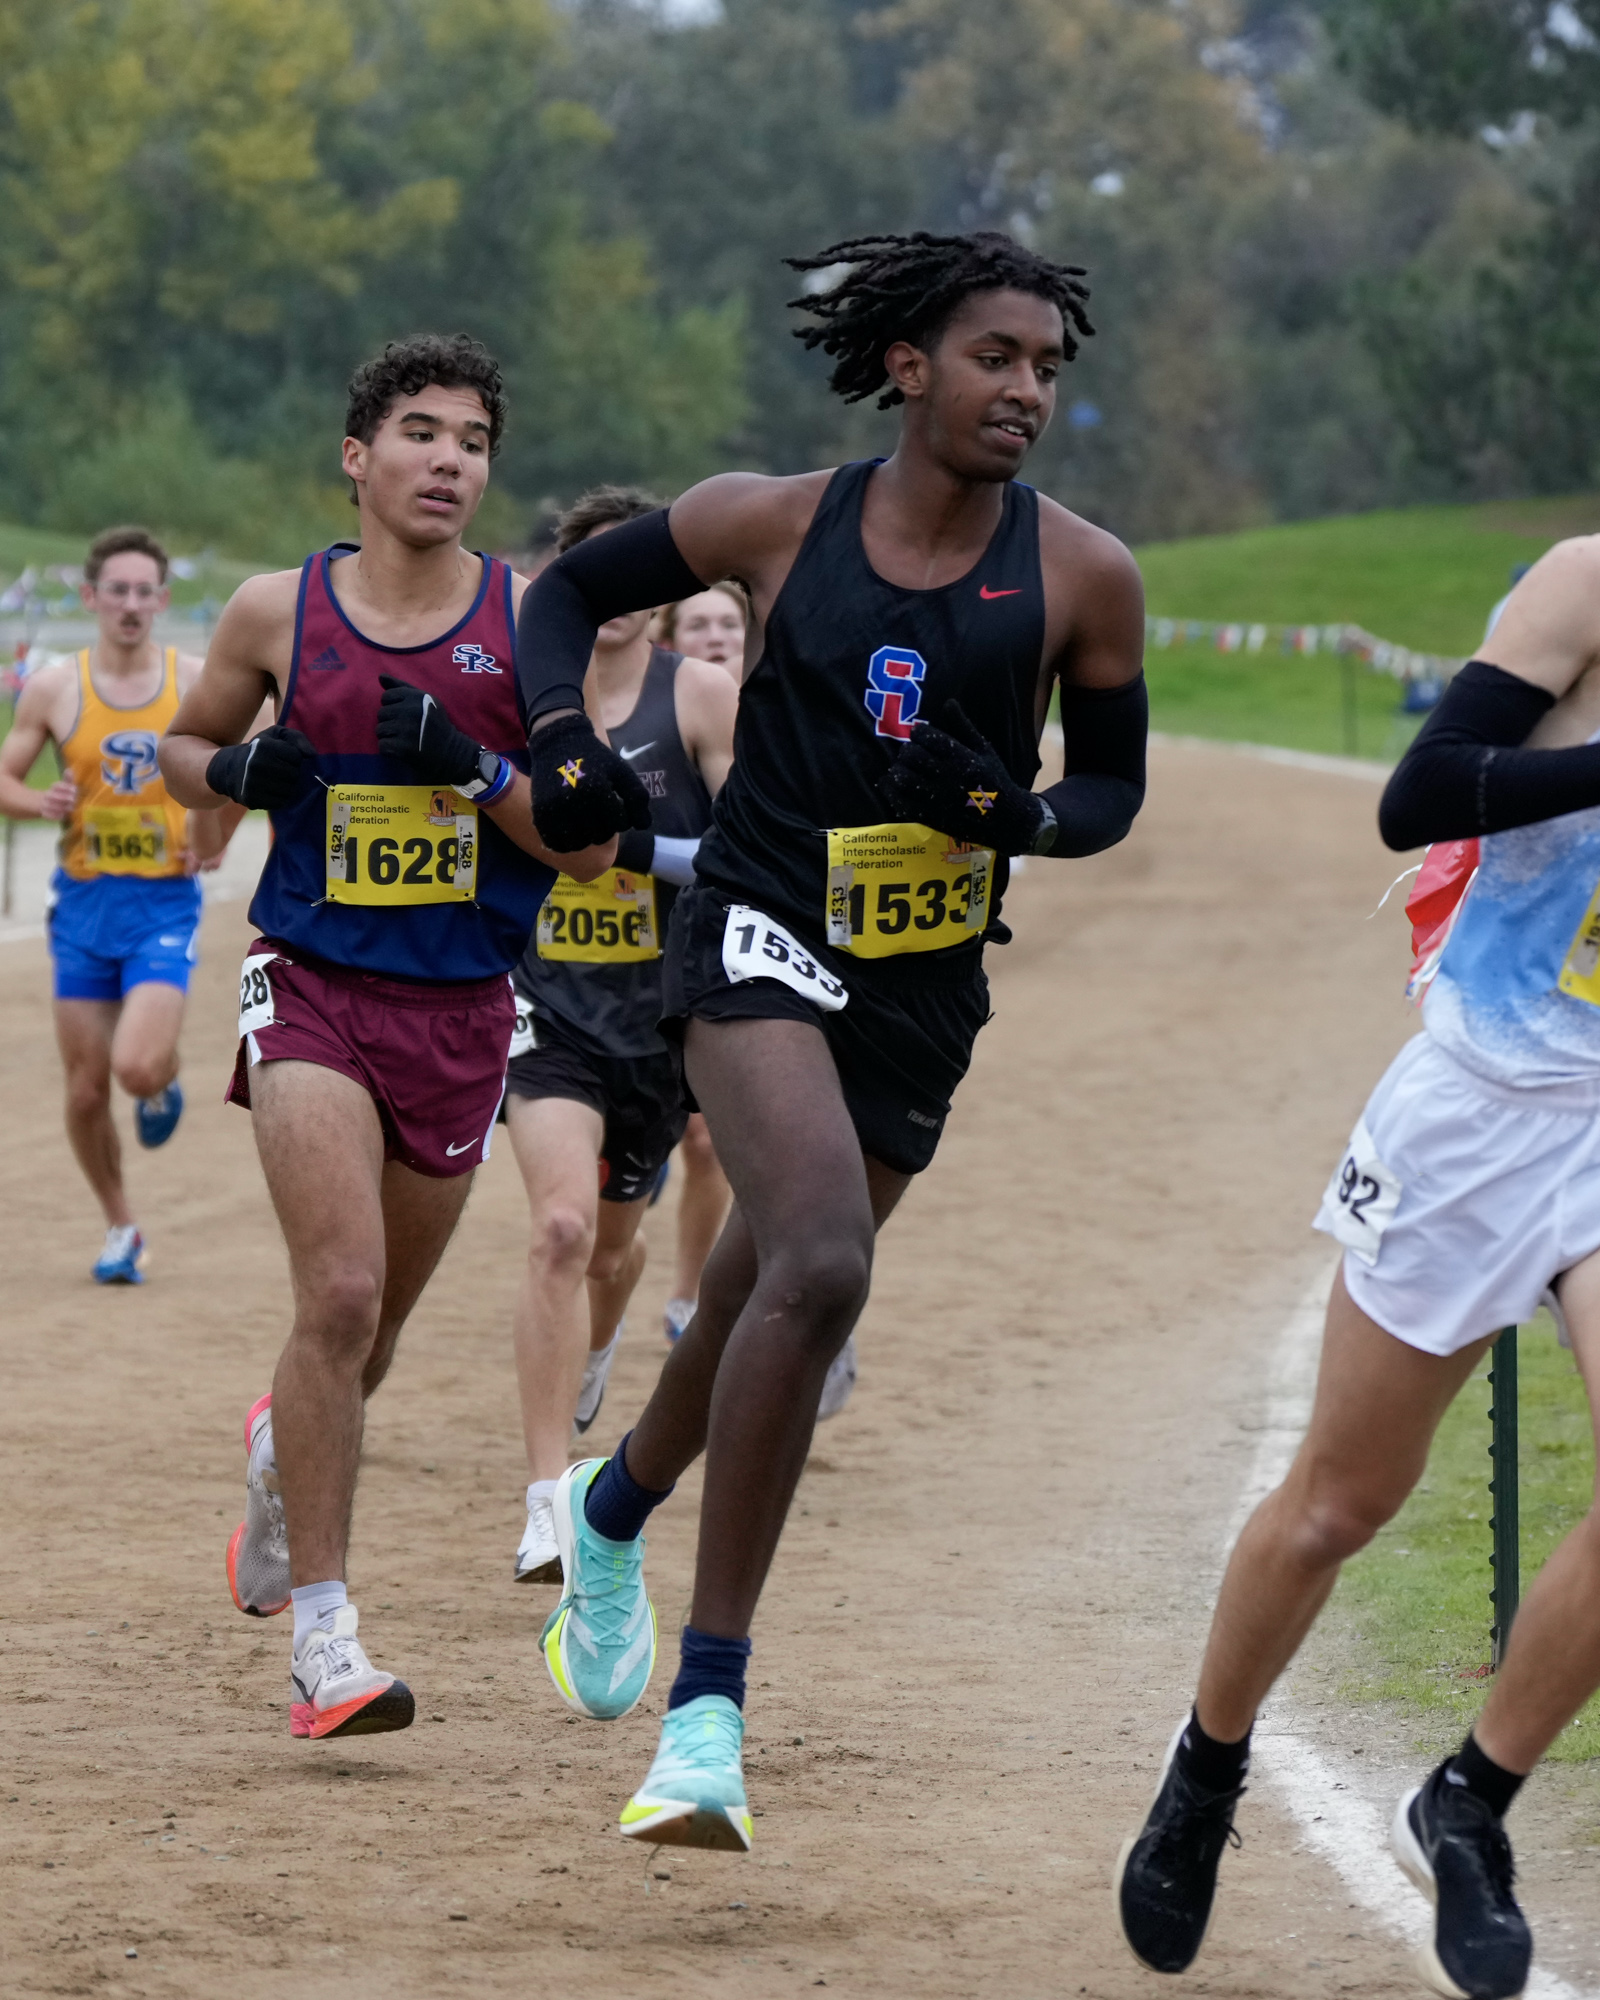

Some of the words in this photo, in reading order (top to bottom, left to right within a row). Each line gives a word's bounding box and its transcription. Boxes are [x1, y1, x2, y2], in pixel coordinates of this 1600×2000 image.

[338, 792, 385, 802] California
[350, 804, 410, 814] erscholastic
[350, 816, 390, 825] deration
[842, 833, 898, 844] California
[331, 825, 343, 862] 1628
[345, 837, 459, 885] 1628
[462, 831, 473, 869] 1628
[842, 846, 927, 857] Interscholastic
[831, 886, 844, 928] 1533
[849, 872, 972, 936] 1533
[551, 906, 641, 947] 2056
[1339, 1156, 1380, 1225] 92
